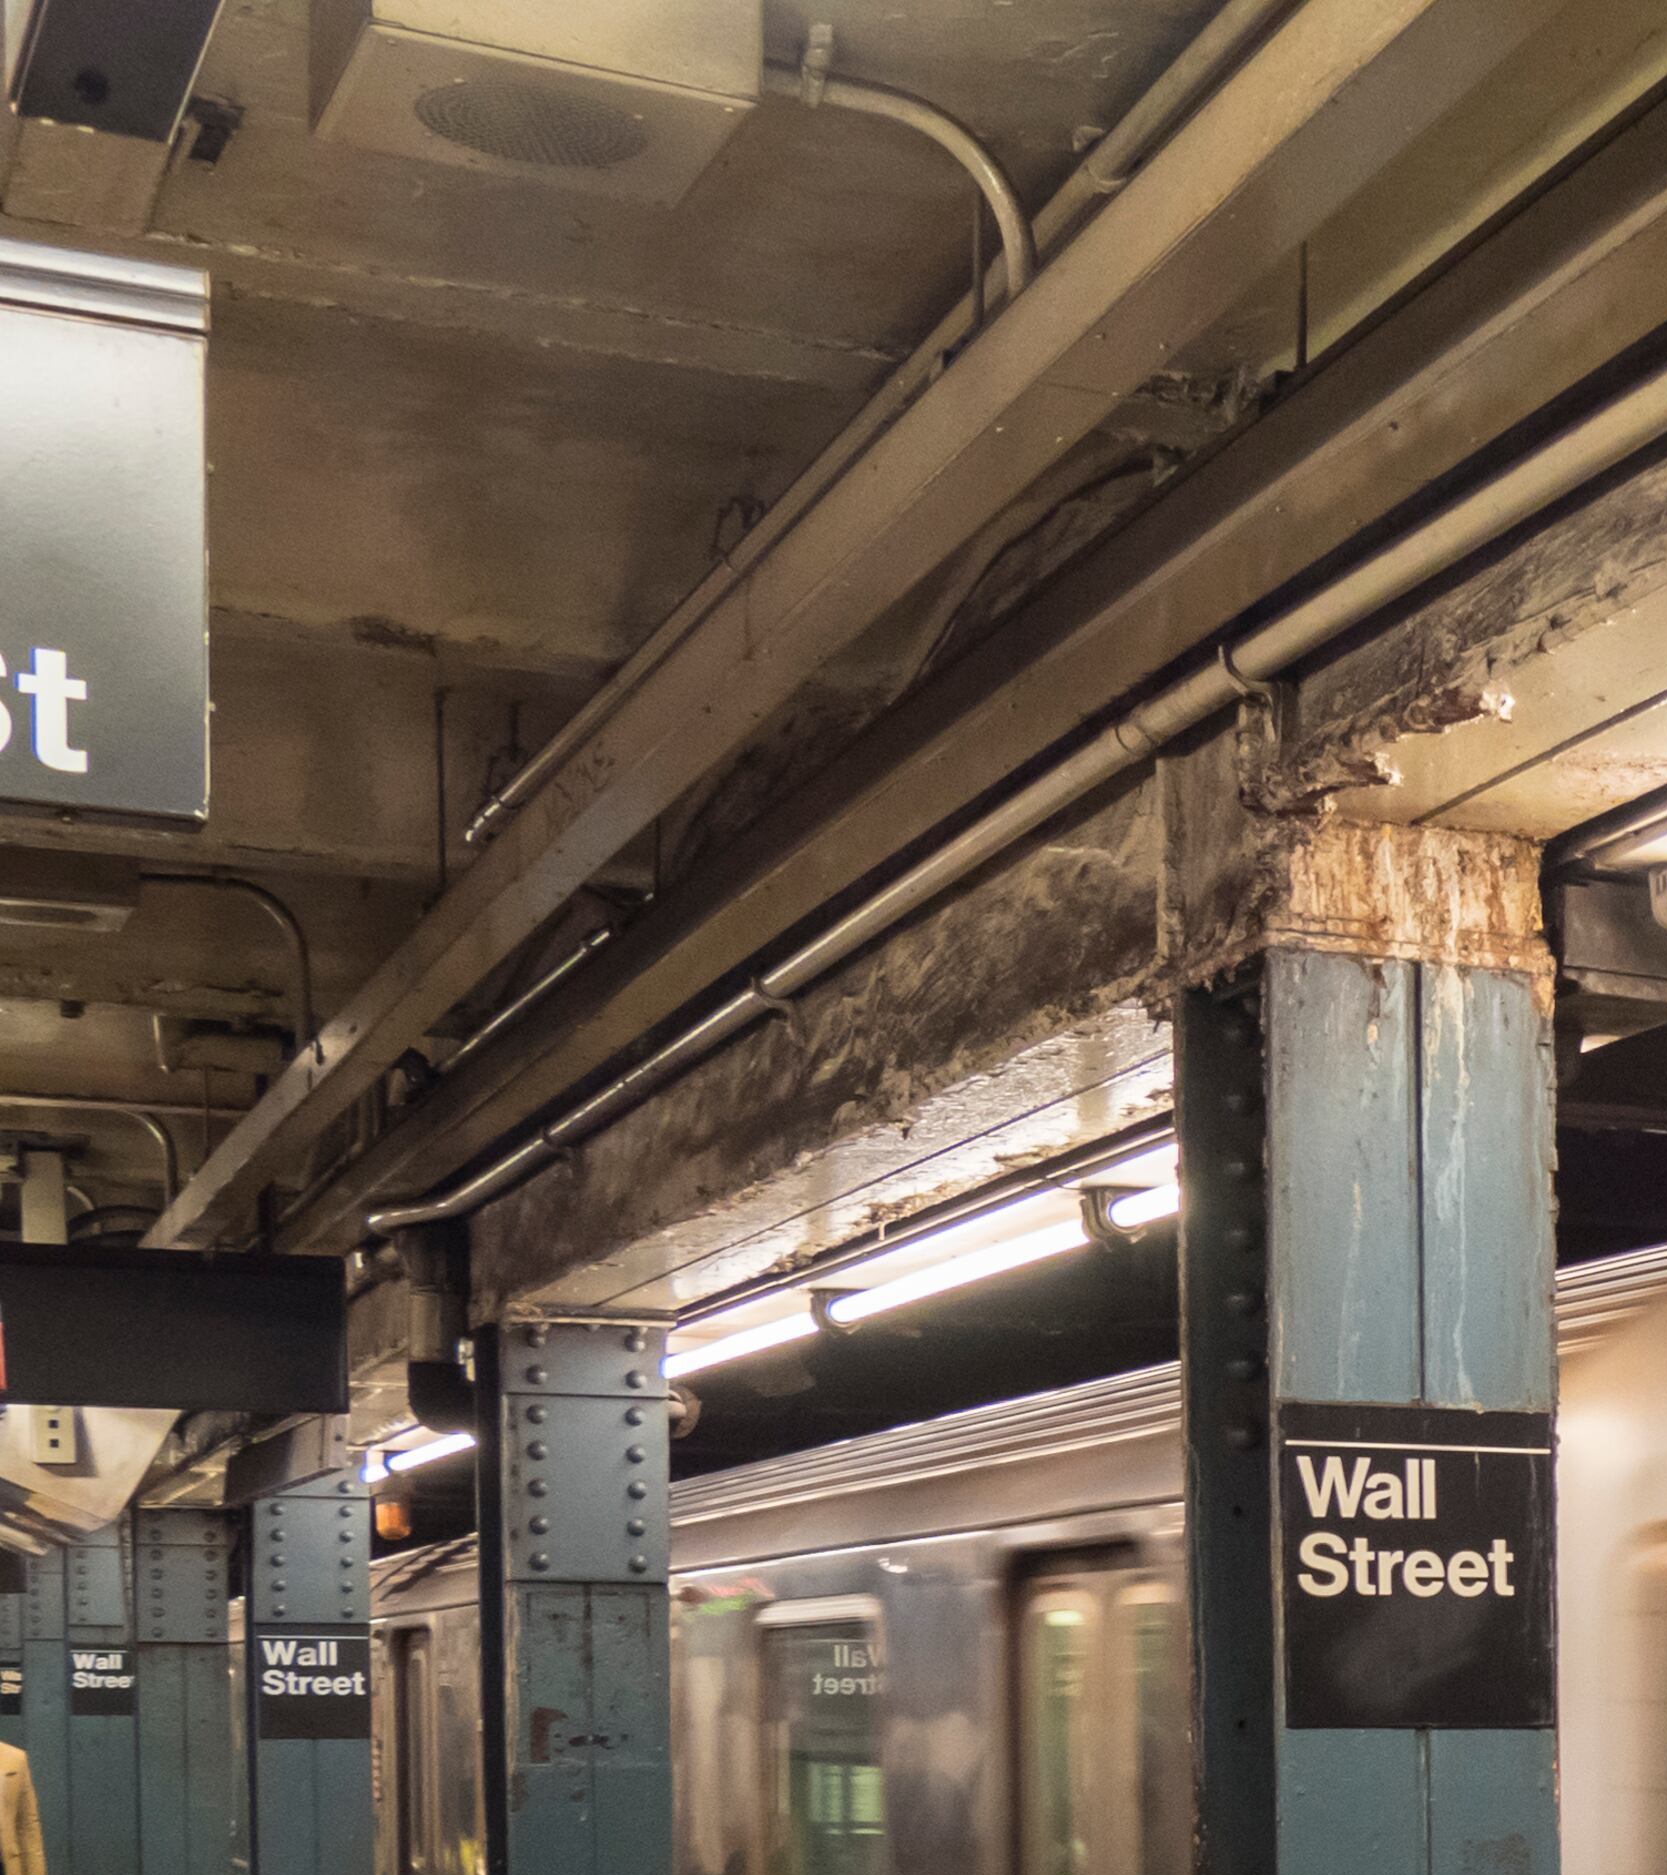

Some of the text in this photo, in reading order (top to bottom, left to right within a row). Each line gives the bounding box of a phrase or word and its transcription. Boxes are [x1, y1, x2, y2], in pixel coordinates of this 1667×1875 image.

[0, 645, 88, 773] t
[1296, 1455, 1437, 1520] Wall
[1297, 1531, 1515, 1597] Street
[72, 1653, 123, 1670] Wall
[261, 1640, 338, 1666] Wall
[261, 1670, 366, 1696] Street
